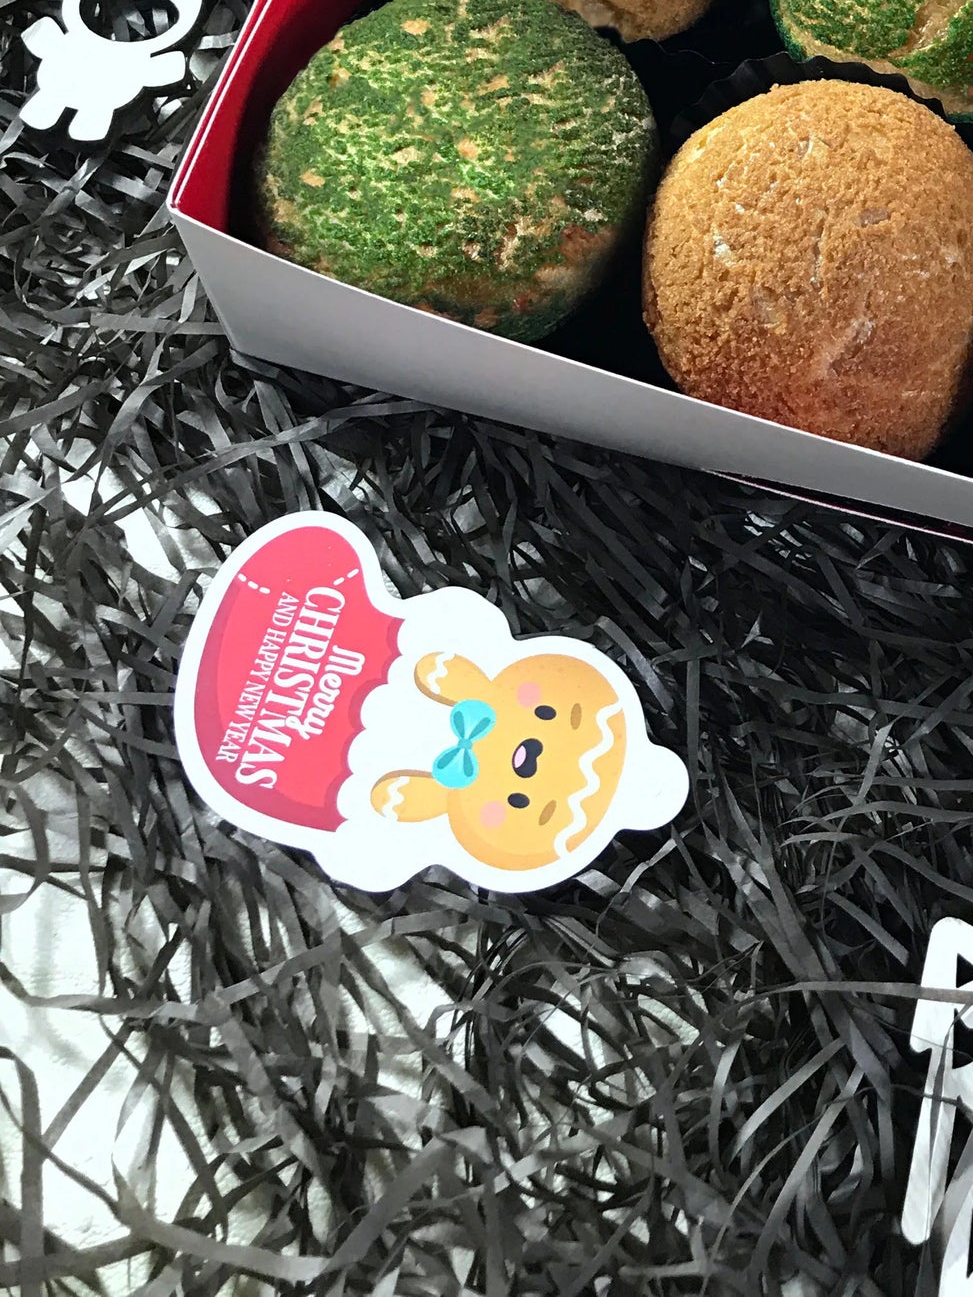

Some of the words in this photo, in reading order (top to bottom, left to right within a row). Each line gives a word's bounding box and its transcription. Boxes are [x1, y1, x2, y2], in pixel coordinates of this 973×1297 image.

[271, 591, 300, 627] AND
[250, 628, 288, 682] HAPPY
[235, 586, 347, 790] CHRISTMAS
[235, 681, 266, 721] NEW
[215, 717, 251, 763] YEAR
